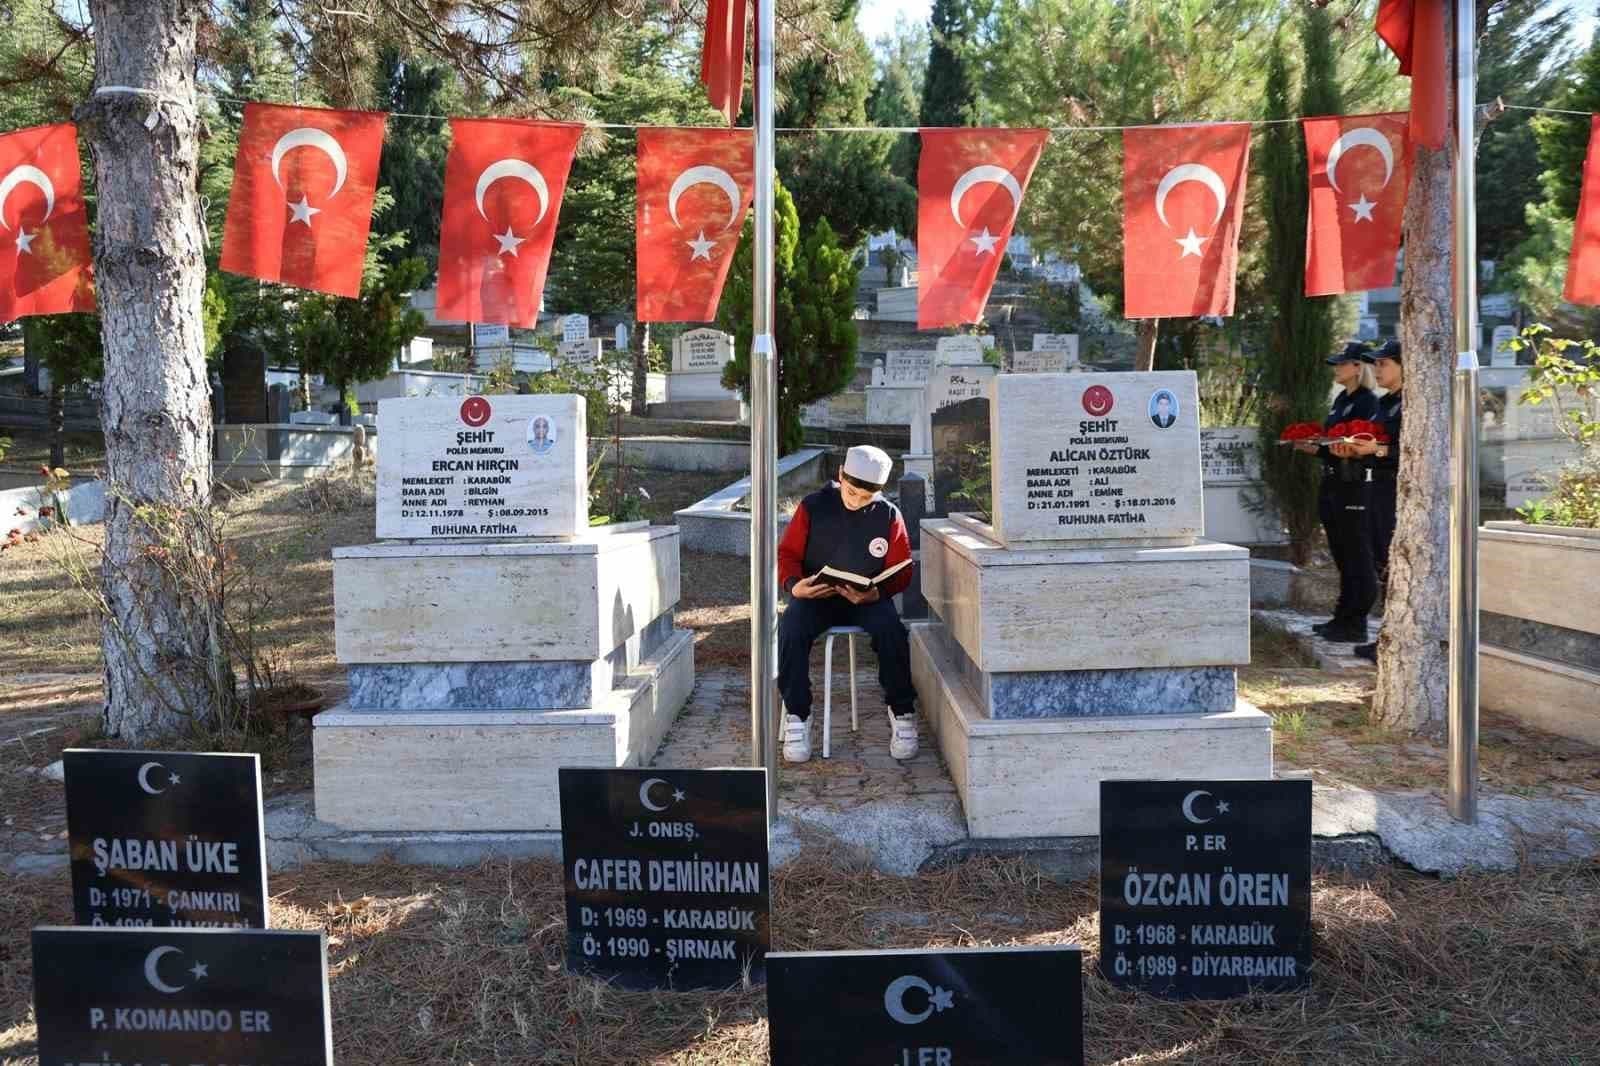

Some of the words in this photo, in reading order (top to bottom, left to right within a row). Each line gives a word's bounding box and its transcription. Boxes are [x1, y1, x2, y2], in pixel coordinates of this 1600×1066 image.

[1080, 418, 1118, 435] ŞEHİT
[456, 430, 495, 446] ŞEHİT
[1070, 436, 1092, 445] POLİS
[1094, 436, 1128, 444] MEMURU
[446, 446, 468, 455] POLİS
[470, 447, 504, 455] MEMURU
[1049, 448, 1097, 462] ALİCAN
[1099, 447, 1151, 460] ÖZTÜRK
[432, 460, 474, 471] ERCAN
[477, 459, 519, 473] HIRÇIN
[1026, 466, 1079, 476] MEMLEKETİ
[402, 476, 454, 485] MEMLEKETİ
[1027, 479, 1052, 488] BABA
[1054, 478, 1071, 487] ADI
[402, 488, 427, 496] BABA
[428, 487, 445, 496] ADI
[1027, 490, 1054, 499] ANNE
[1057, 489, 1073, 498] ADI
[402, 498, 428, 507] ANNE
[430, 498, 447, 507] ADI
[1058, 514, 1106, 525] RUHUNA
[1108, 512, 1146, 524] FATİHA
[431, 525, 477, 536] RUHUNA
[479, 523, 518, 535] FATİHA
[629, 822, 643, 838] J.
[648, 822, 700, 842] ONBŞ.
[1186, 835, 1198, 850] P.
[1203, 835, 1226, 850] ER
[93, 837, 178, 877] ŞABAN
[186, 834, 240, 874] ÜKE
[574, 858, 643, 891] CAFER
[649, 853, 760, 894] DEMİRHAN
[1123, 866, 1211, 906] ÖZCAN
[1219, 866, 1289, 906] ÖREN
[90, 887, 106, 907] D:
[112, 889, 150, 908] 1971
[167, 890, 241, 914] ÇANKIRI
[581, 907, 599, 927] D:
[604, 907, 648, 927] 1969
[663, 906, 755, 930] KARABÜK
[1114, 924, 1131, 945] D:
[1136, 924, 1176, 945] 1968
[1191, 921, 1275, 945] KARABÜK
[583, 932, 601, 956] Ö:
[607, 937, 650, 957] 1990
[666, 938, 737, 963] ŞIRNAK
[1114, 952, 1132, 976] Ö:
[1137, 956, 1177, 976] 1989
[1191, 951, 1297, 977] DİYARBAKIR
[90, 1007, 108, 1029] P.
[115, 1007, 233, 1032] KOMANDO
[240, 1010, 272, 1033] ER
